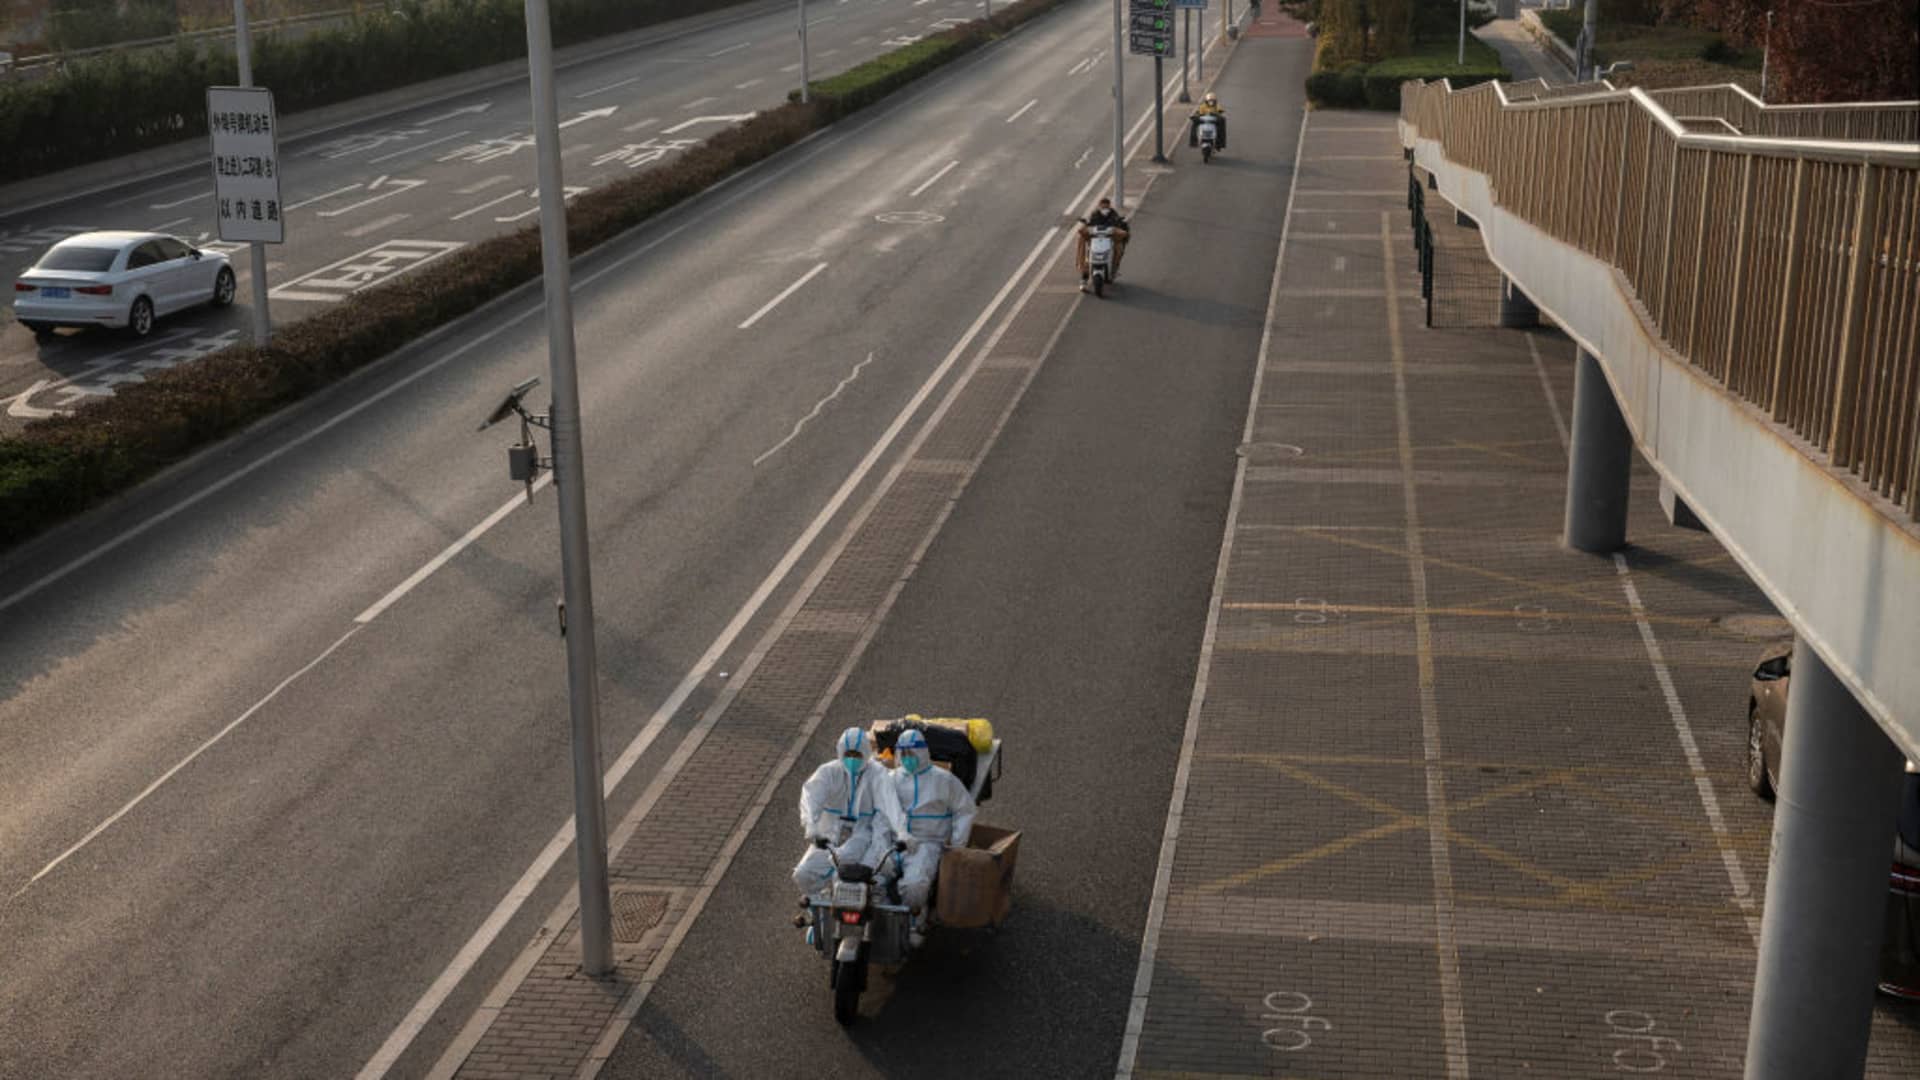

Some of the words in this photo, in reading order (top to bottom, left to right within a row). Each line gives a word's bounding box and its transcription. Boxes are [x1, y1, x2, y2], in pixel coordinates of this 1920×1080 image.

[221, 198, 279, 222] 以内道路
[1260, 990, 1333, 1051] ofo
[1604, 1008, 1684, 1073] ofo
